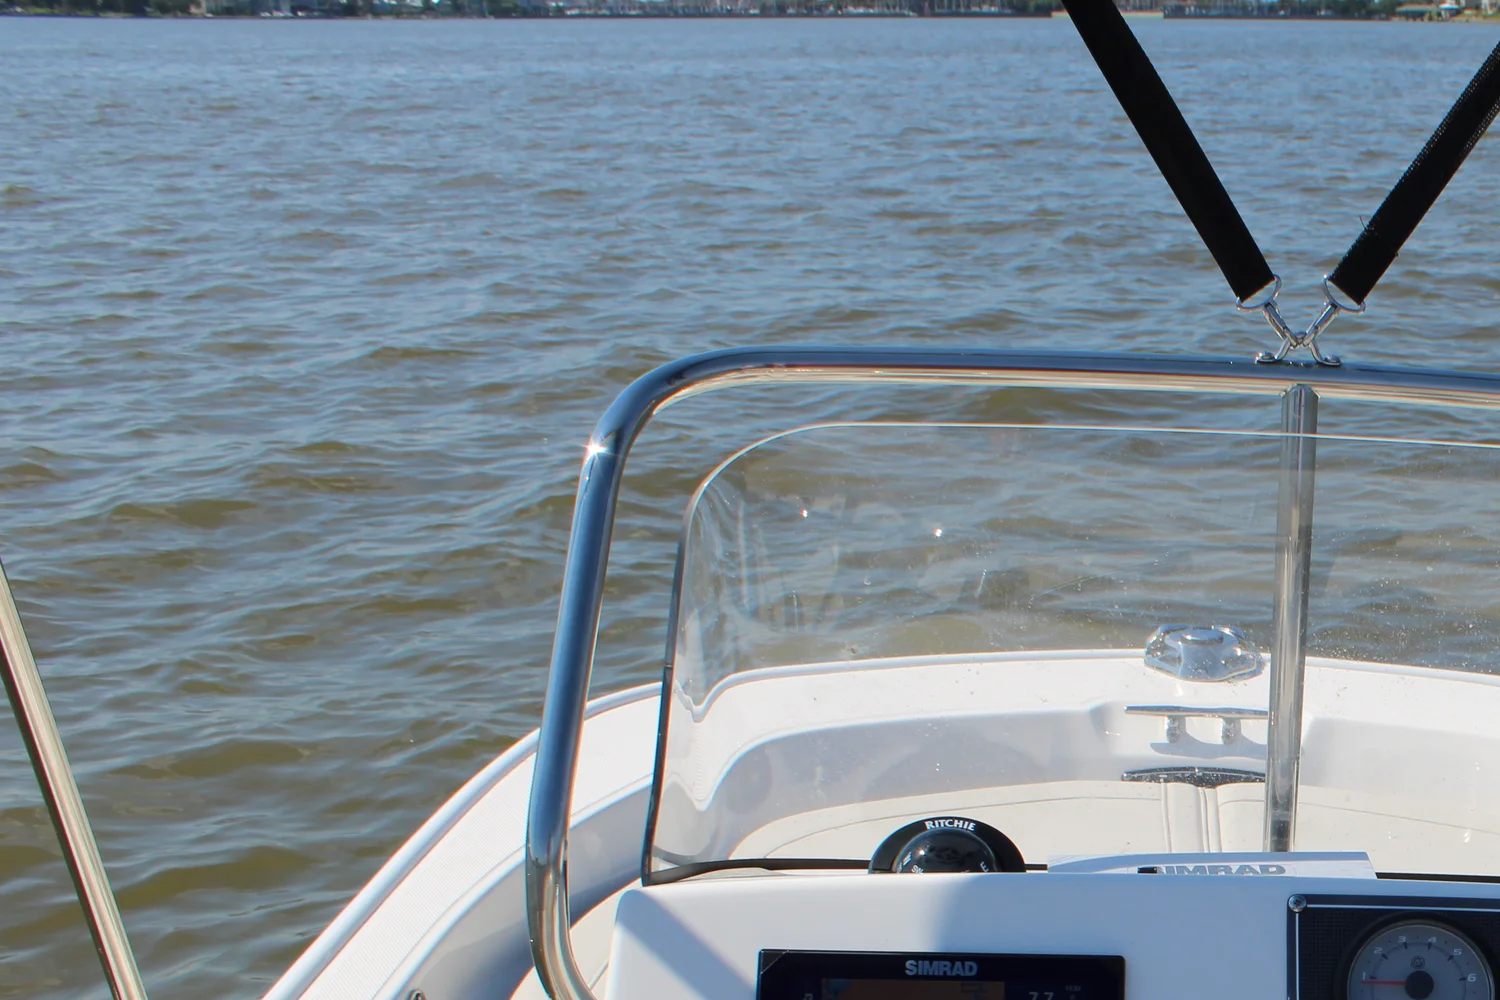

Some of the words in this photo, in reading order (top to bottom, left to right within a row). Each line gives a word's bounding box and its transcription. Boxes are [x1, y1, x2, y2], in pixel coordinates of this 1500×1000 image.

[924, 819, 976, 831] RITCHIE
[1157, 864, 1286, 875] IMRAD
[905, 959, 978, 977] SIMRAD
[1467, 973, 1477, 982] 6
